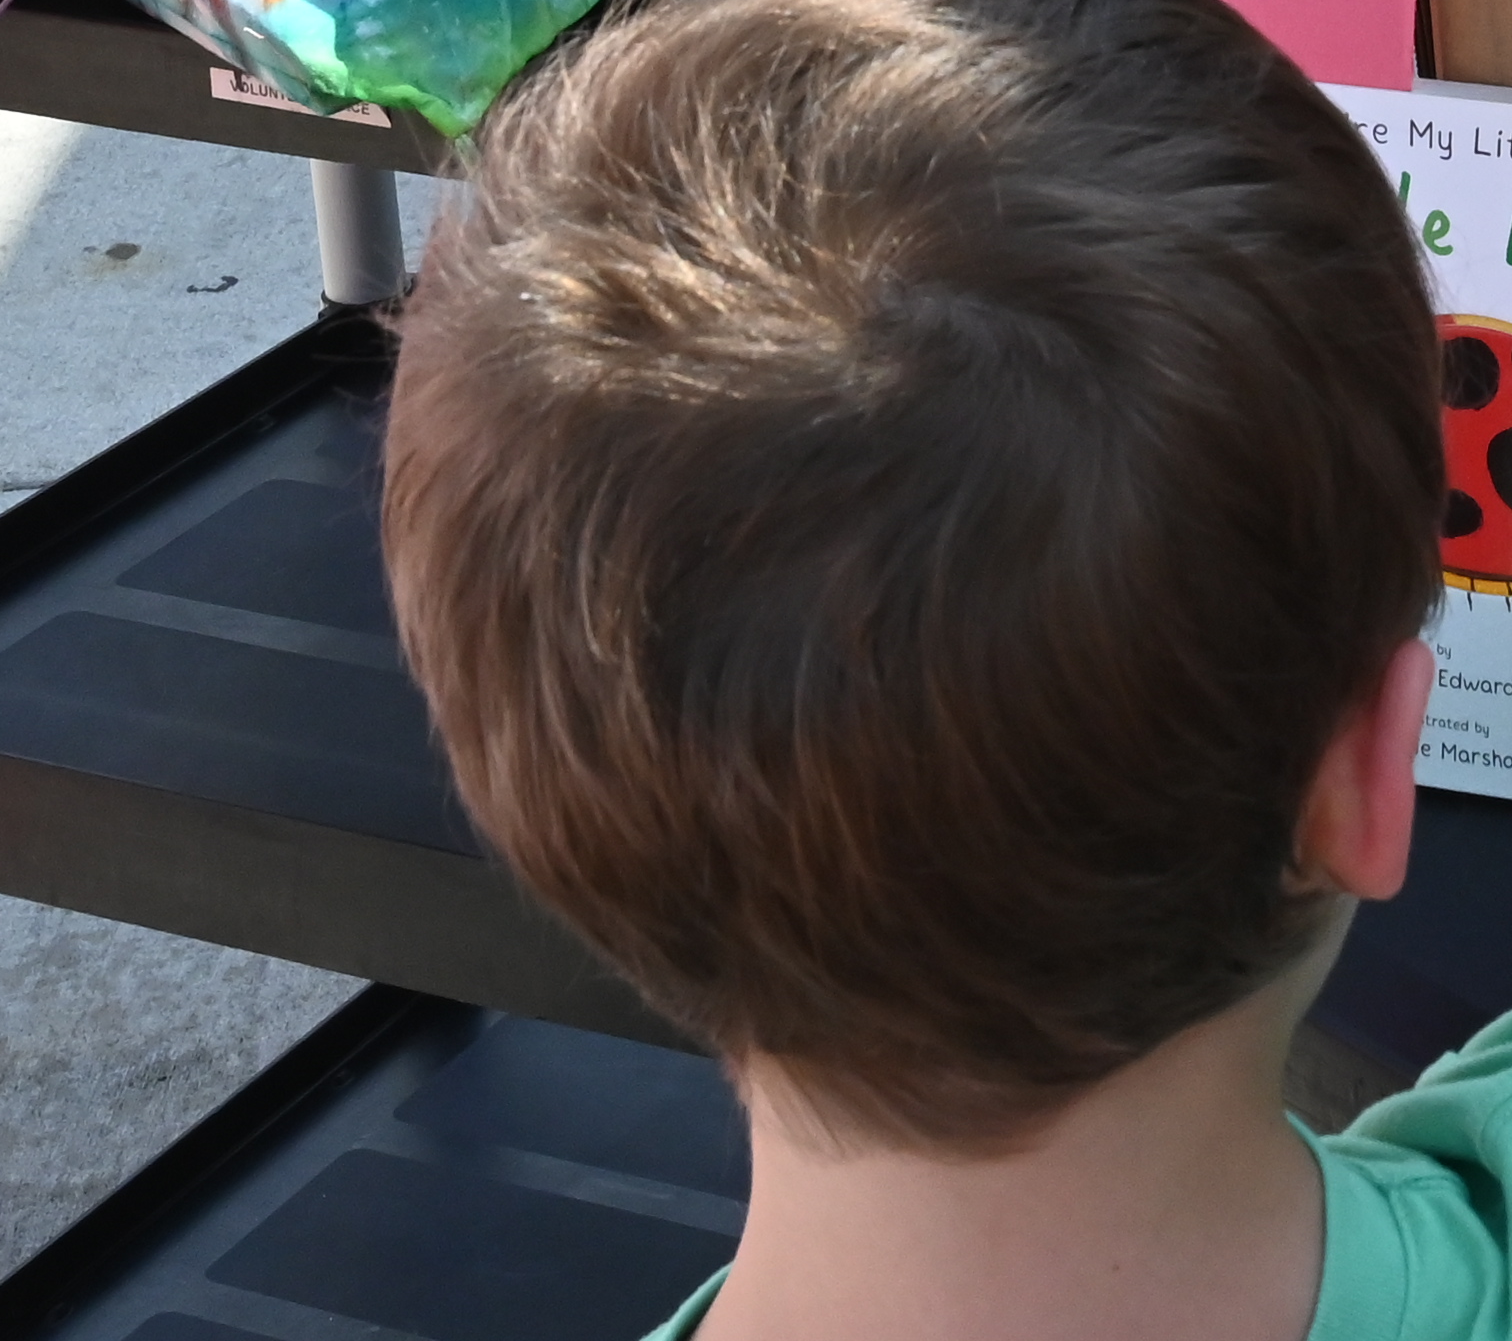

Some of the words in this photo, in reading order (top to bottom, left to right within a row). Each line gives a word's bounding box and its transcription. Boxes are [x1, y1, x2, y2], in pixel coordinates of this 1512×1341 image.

[1408, 118, 1454, 161] My
[1436, 642, 1452, 660] by
[1474, 721, 1490, 739] by
